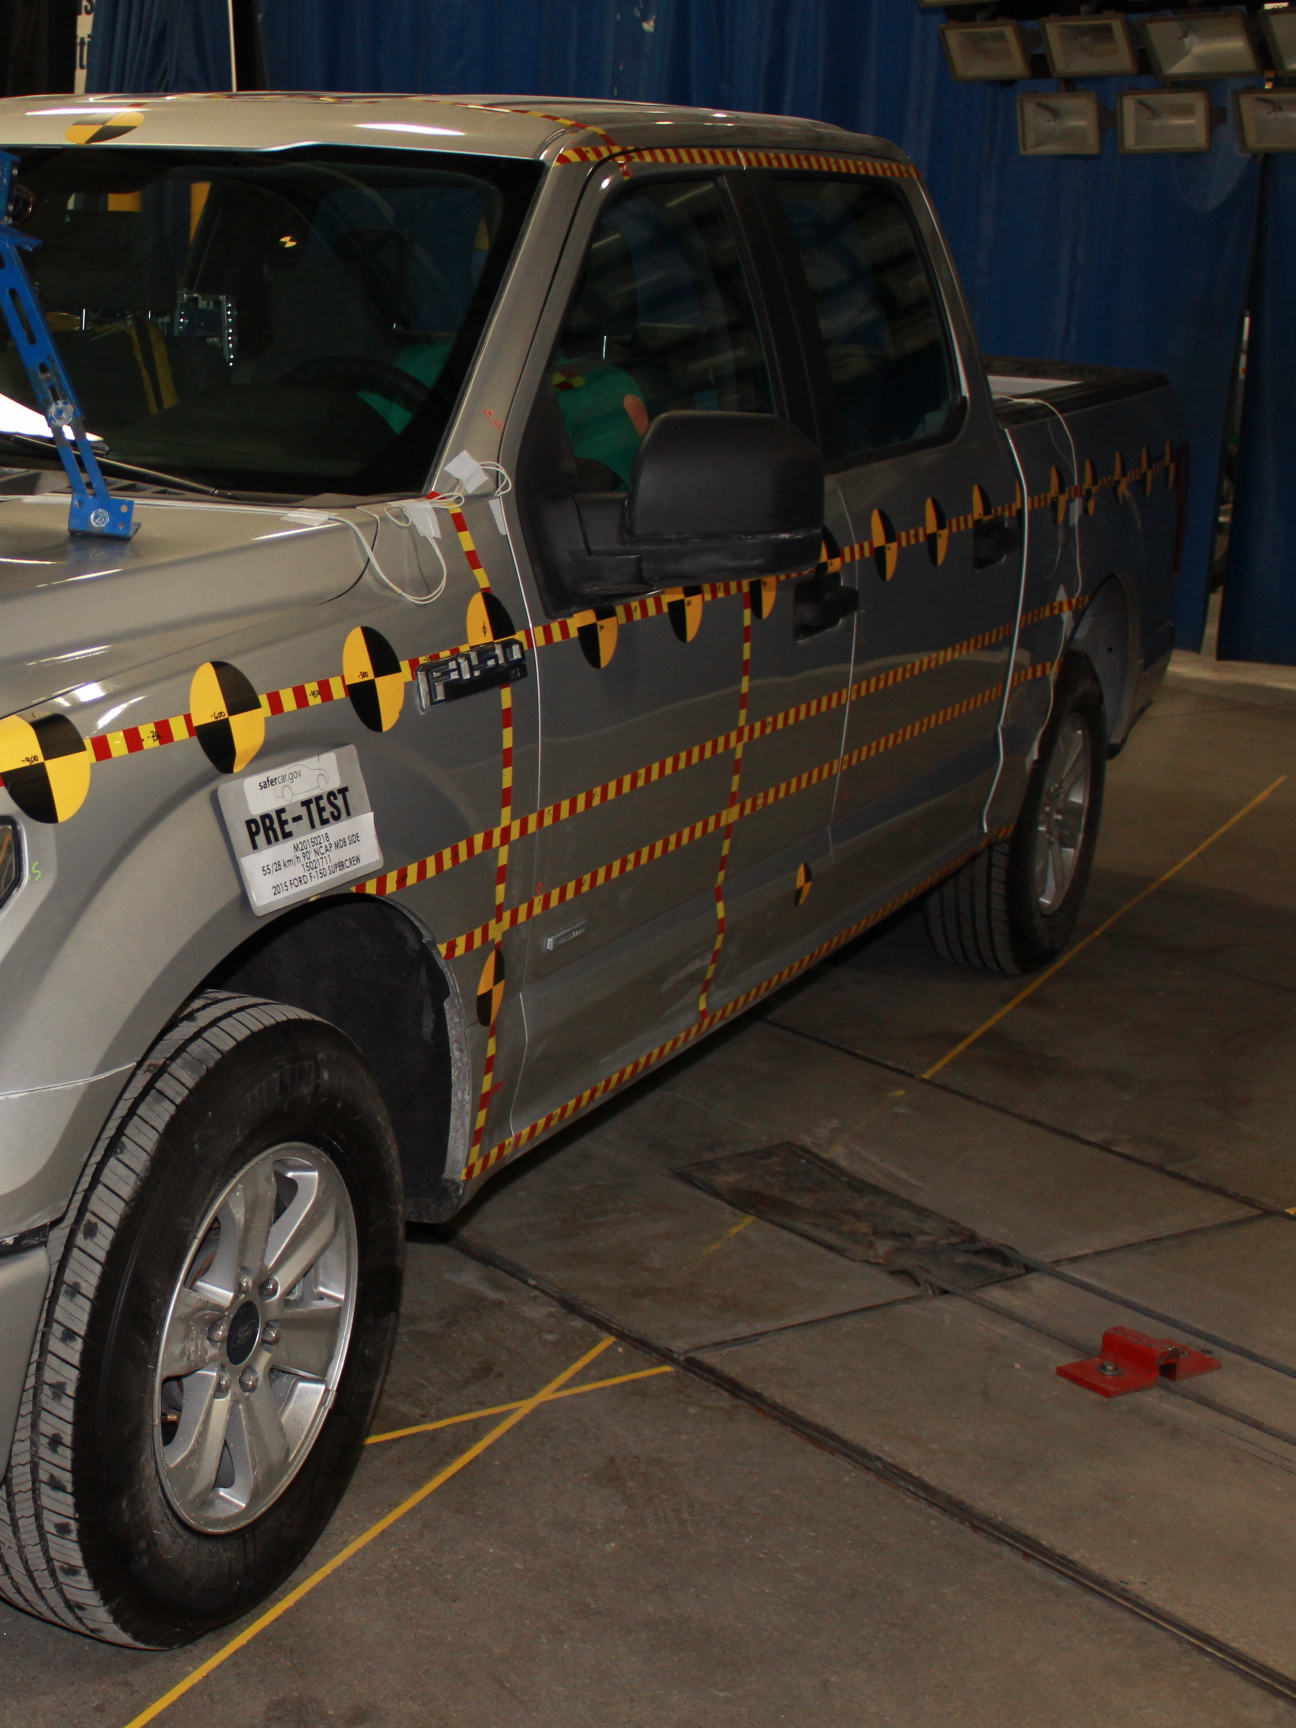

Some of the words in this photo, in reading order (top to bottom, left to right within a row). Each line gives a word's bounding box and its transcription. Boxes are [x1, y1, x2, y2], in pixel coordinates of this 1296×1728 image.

[258, 768, 303, 791] safercar.gov
[245, 786, 352, 850] PRE-TEST
[262, 860, 283, 876] 55/28
[282, 853, 301, 869] km/h
[314, 844, 333, 857] NCAP
[334, 838, 347, 851] MDB
[347, 832, 361, 847] SIDE
[293, 833, 330, 853] M20150218
[272, 881, 290, 896] 2015
[289, 874, 309, 889] FORD
[309, 867, 328, 883] F-150
[328, 854, 361, 875] SUPERCREW
[301, 855, 332, 873] 15021711
